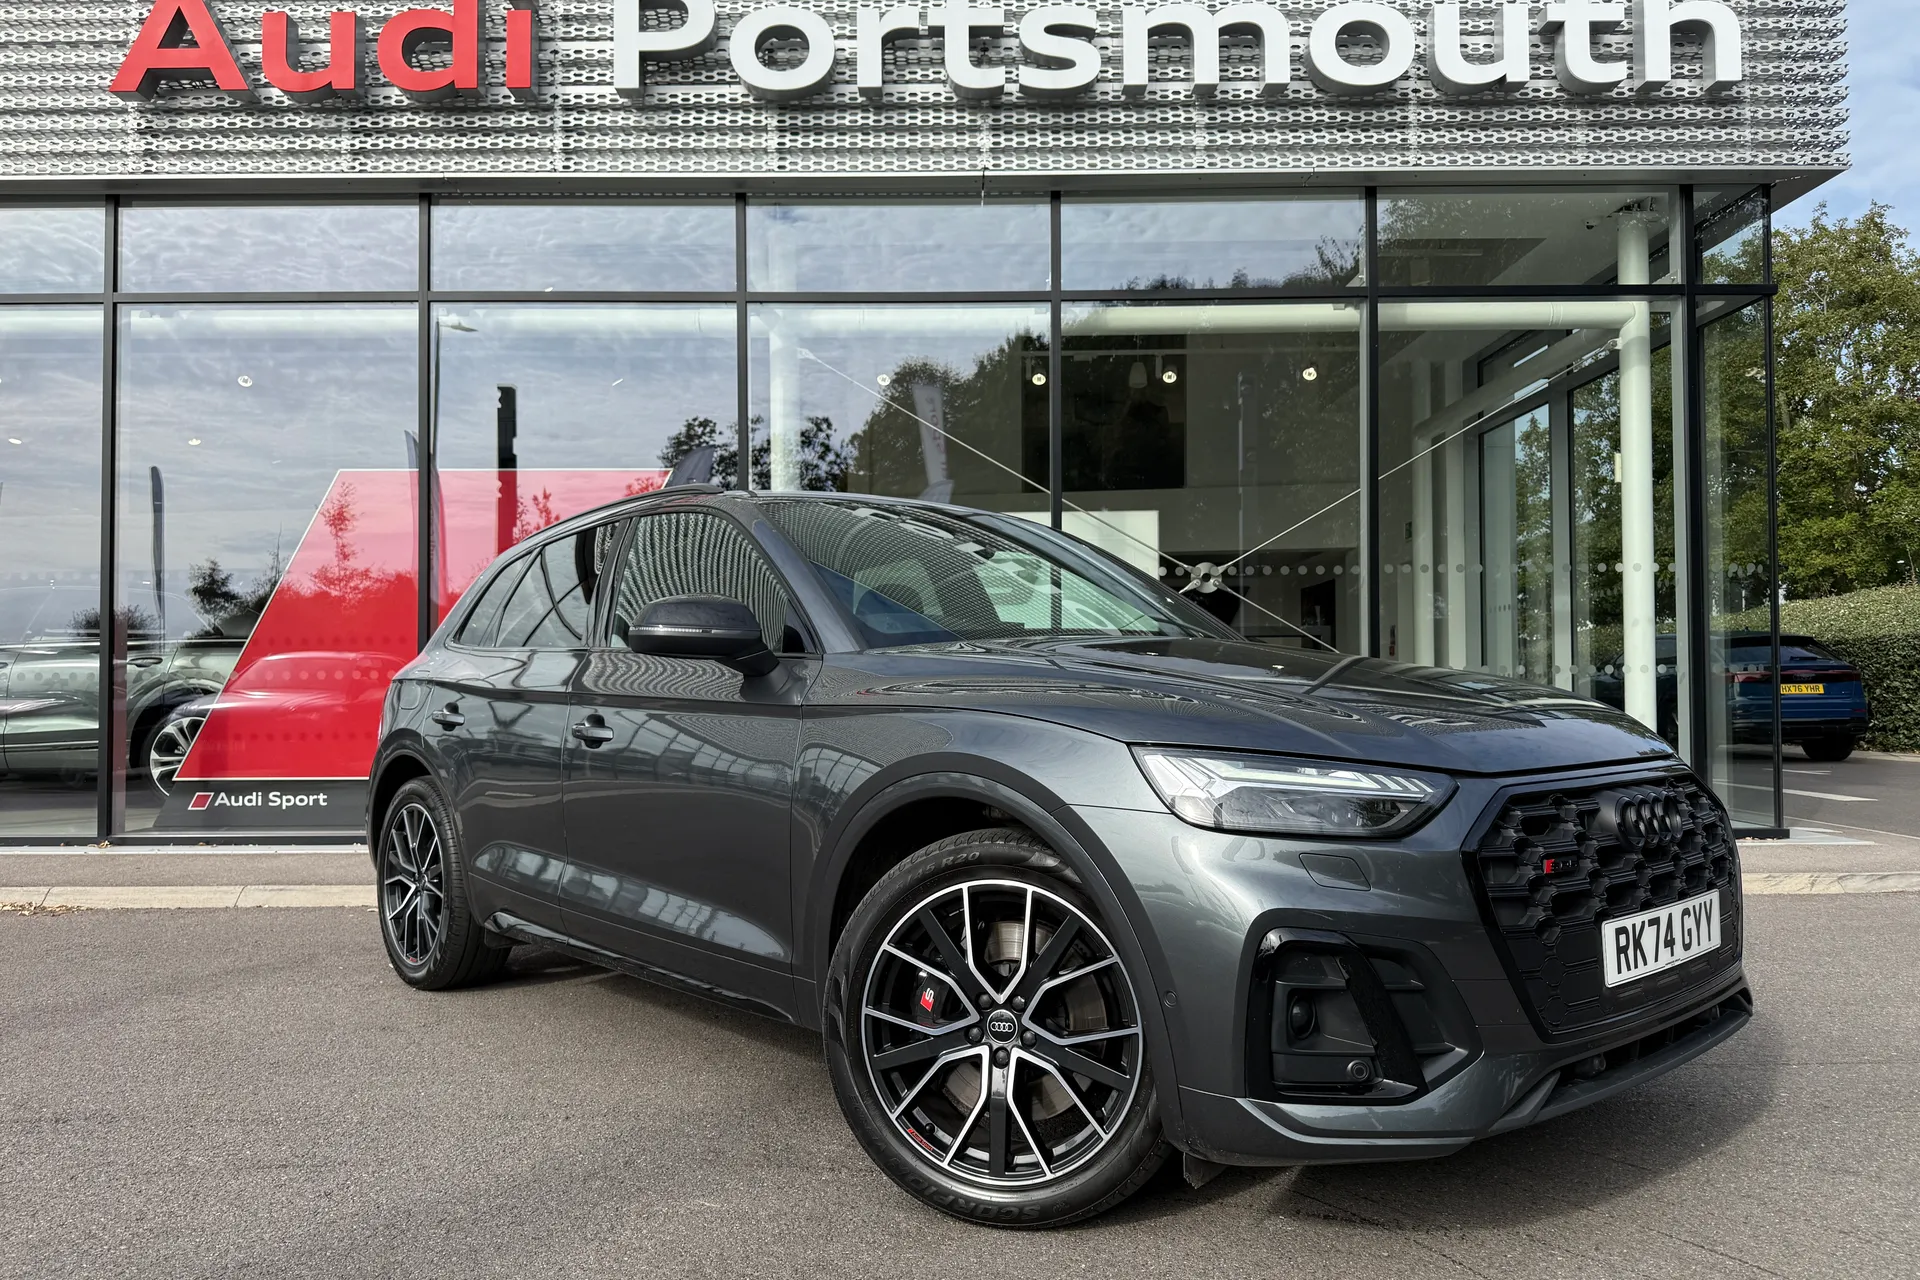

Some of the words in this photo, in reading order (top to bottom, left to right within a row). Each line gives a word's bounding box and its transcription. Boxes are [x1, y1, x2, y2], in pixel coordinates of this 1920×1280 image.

[109, 0, 538, 100] Audi
[612, 0, 1743, 98] Portsmouth
[1781, 684, 1803, 693] HX76
[1804, 684, 1820, 693] YHR
[214, 792, 263, 807] Audi
[268, 792, 328, 810] Sport
[1614, 912, 1676, 975] RK74
[1681, 898, 1714, 952] GYY
